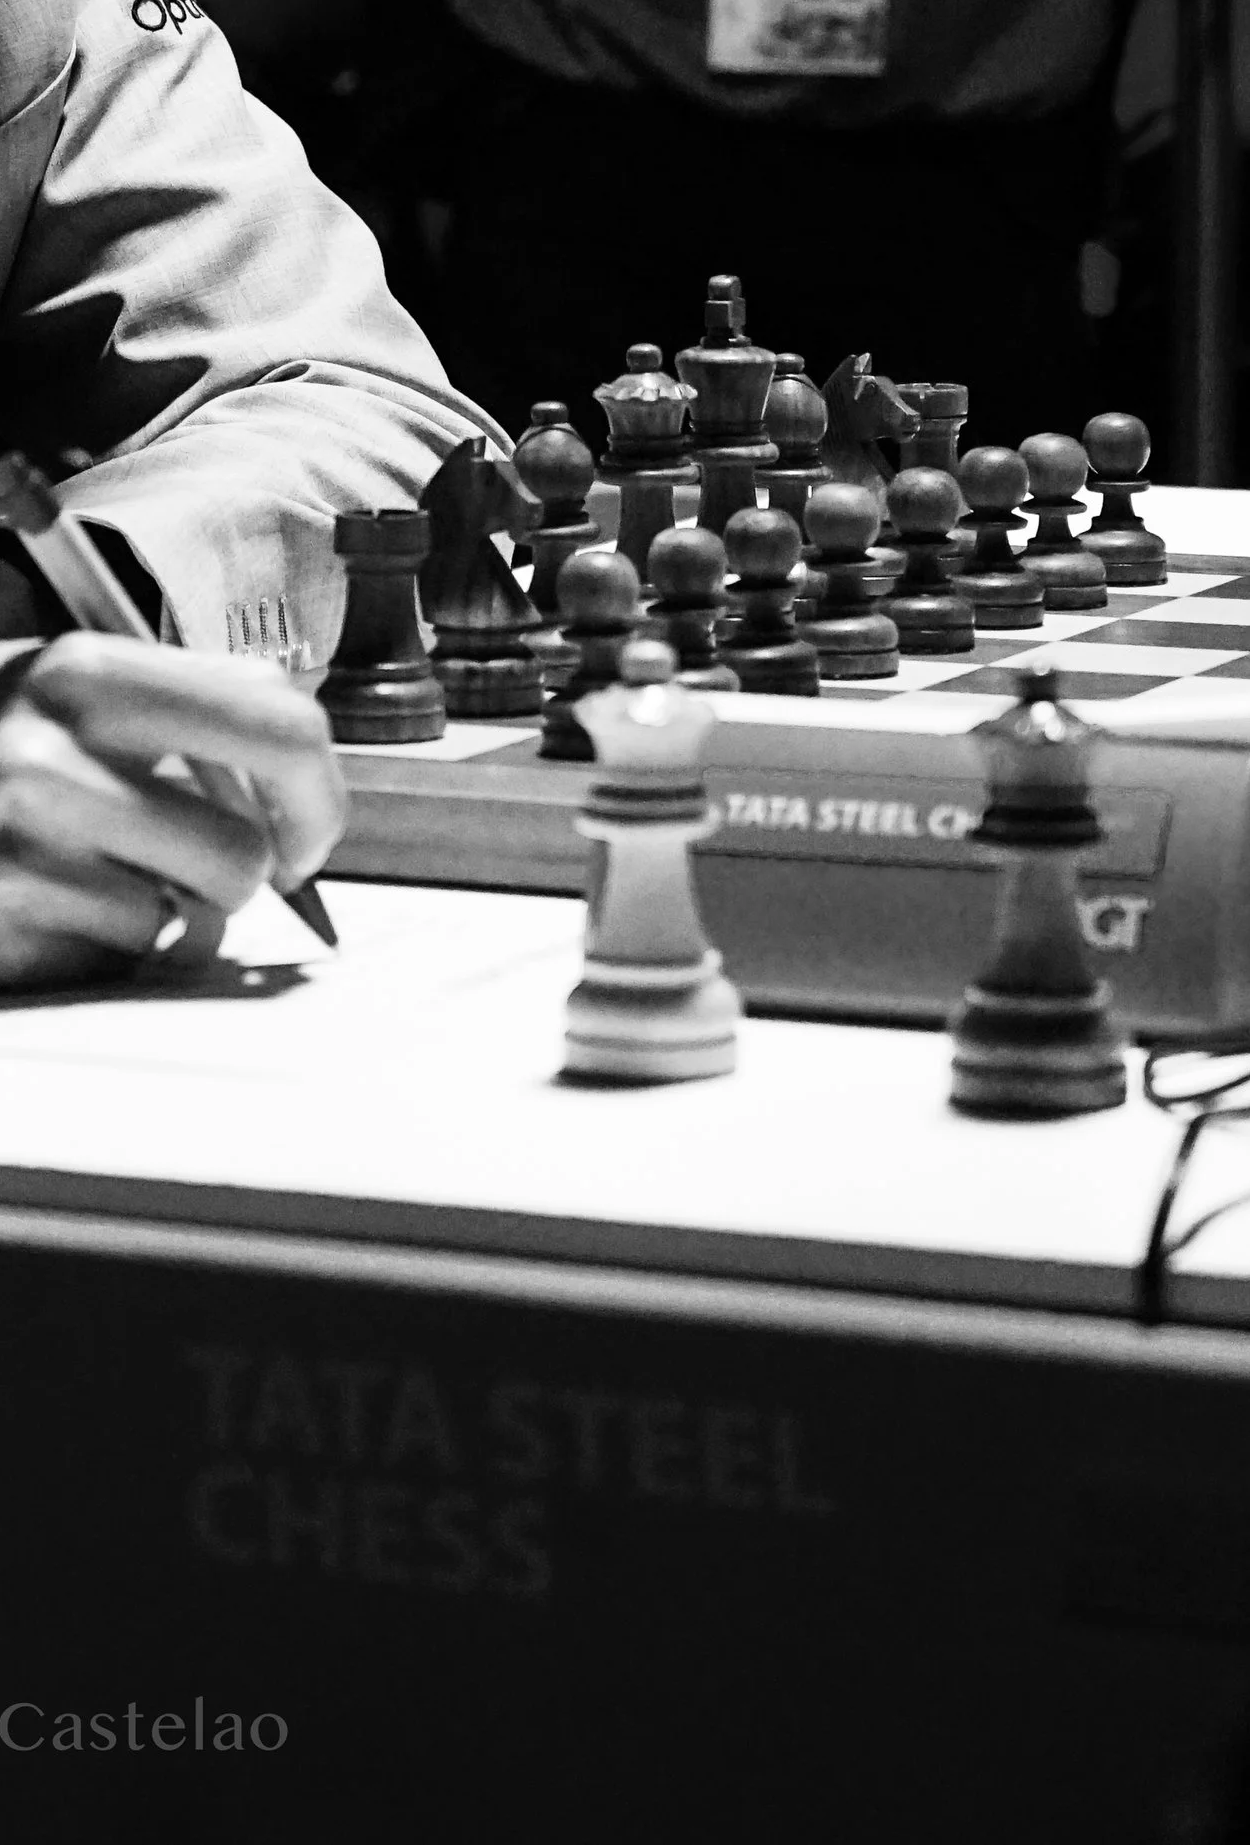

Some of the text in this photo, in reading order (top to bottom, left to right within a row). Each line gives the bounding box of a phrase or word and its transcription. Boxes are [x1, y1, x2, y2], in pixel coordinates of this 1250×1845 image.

[726, 793, 810, 829] TATA
[814, 798, 918, 837] STEEL
[184, 1343, 837, 1516] TATA STEEL
[184, 1462, 552, 1601] CHESS
